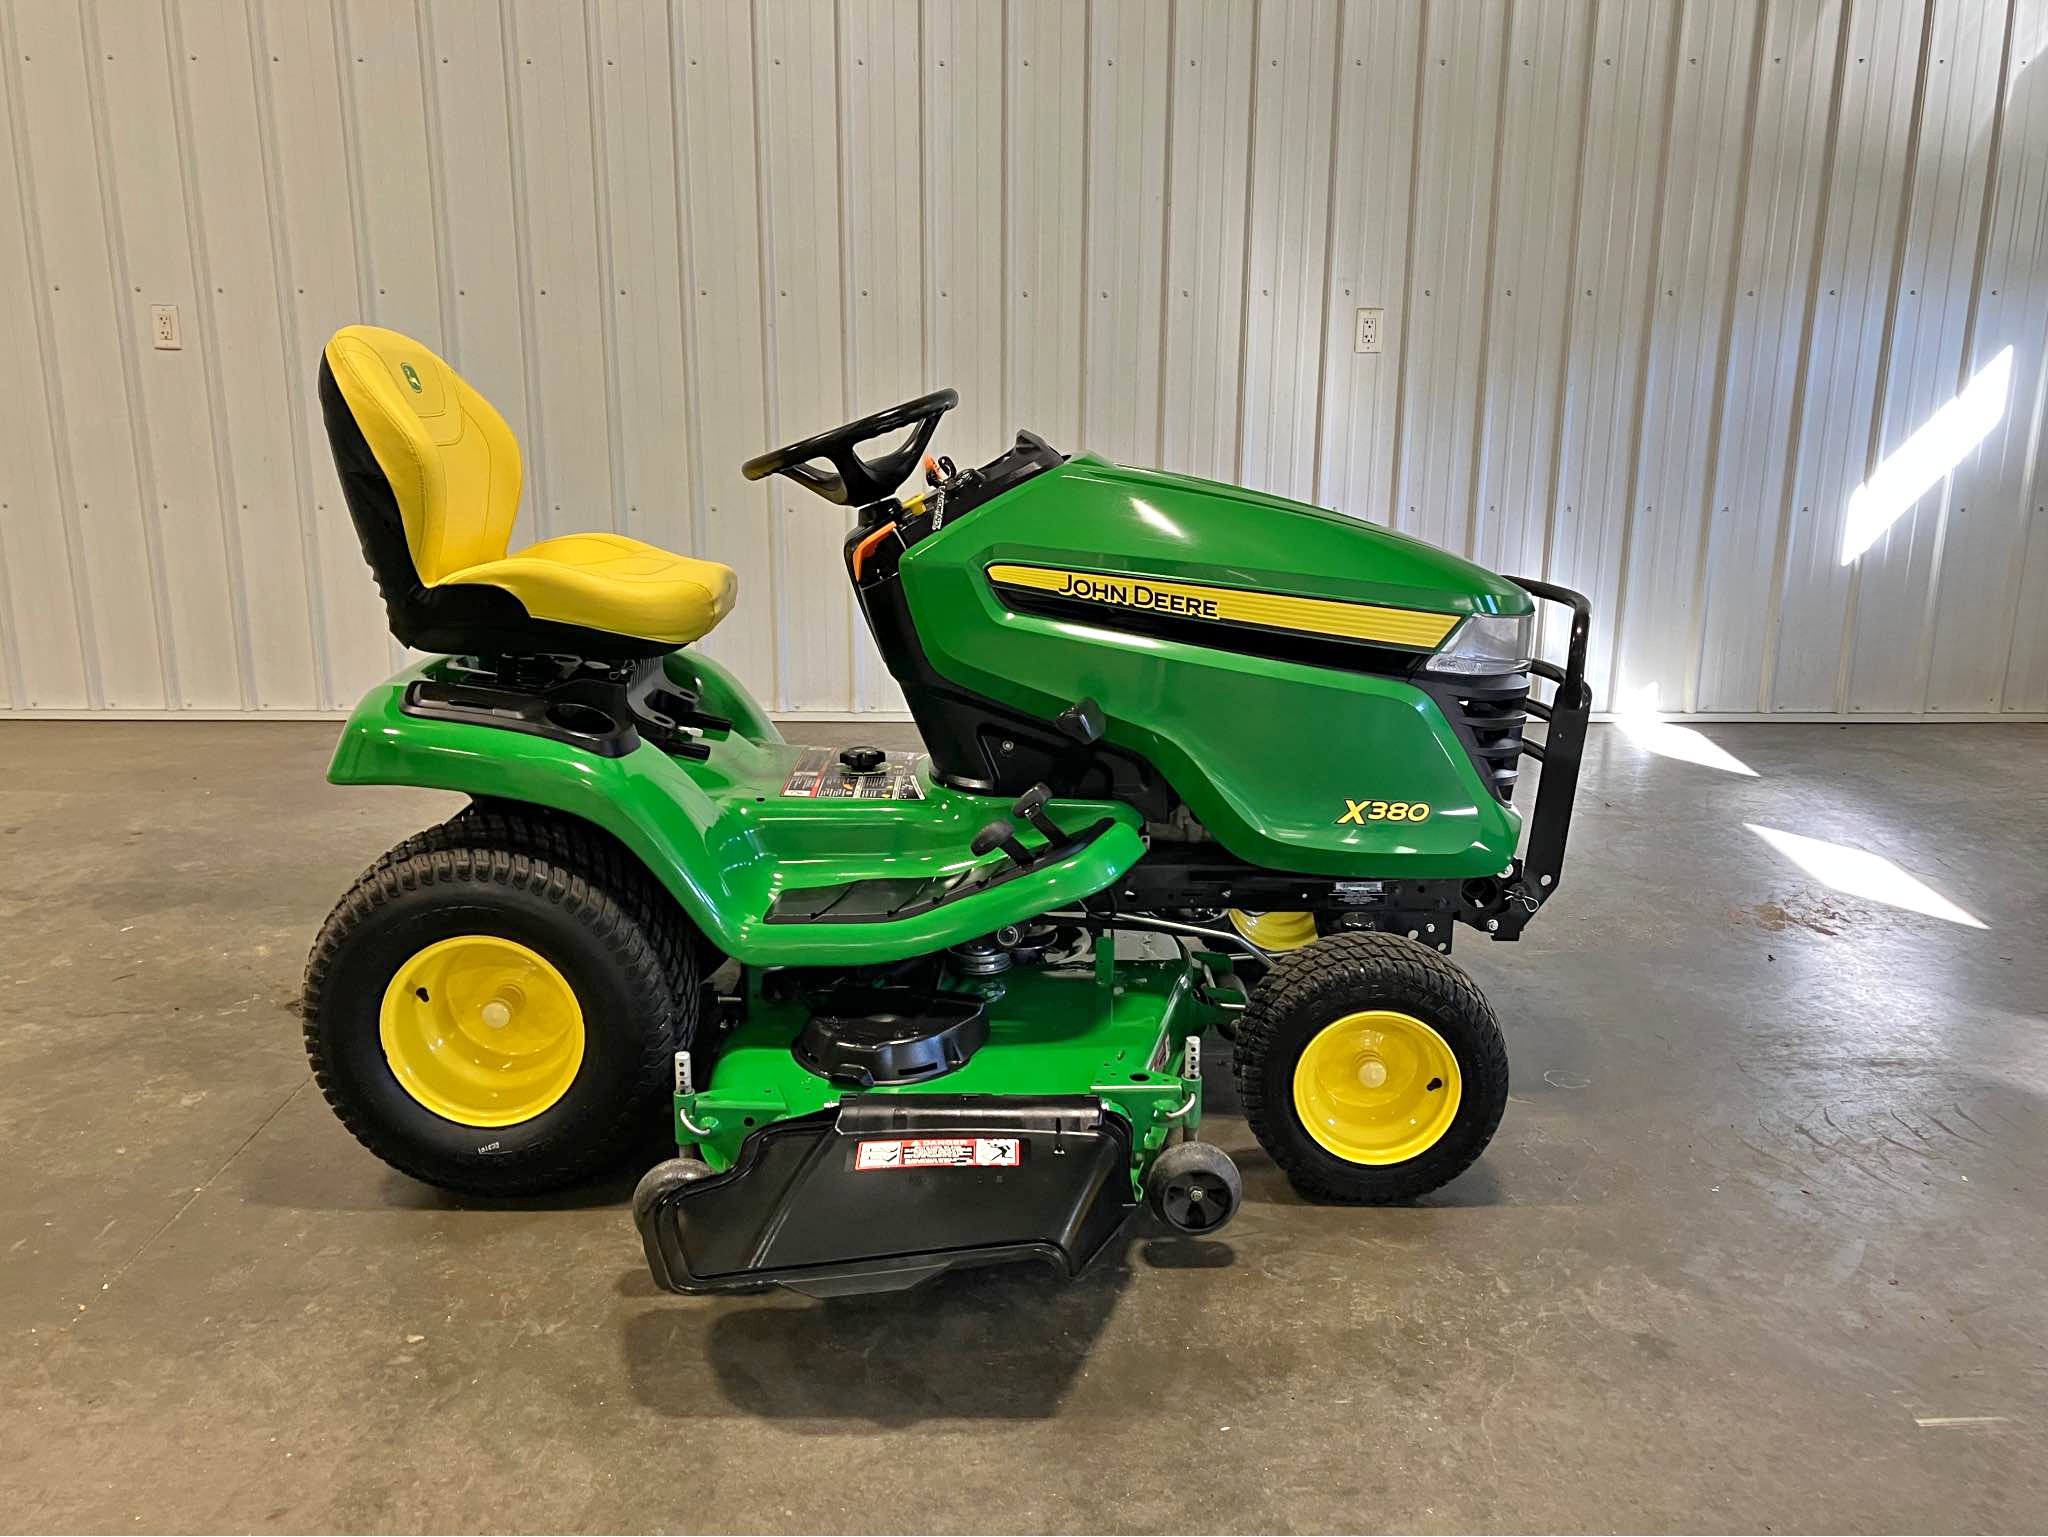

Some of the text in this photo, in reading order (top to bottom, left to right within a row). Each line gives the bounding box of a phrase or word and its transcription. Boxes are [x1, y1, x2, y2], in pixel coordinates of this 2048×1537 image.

[1059, 574, 1219, 618] JOHN DEERE
[1336, 799, 1431, 825] X380
